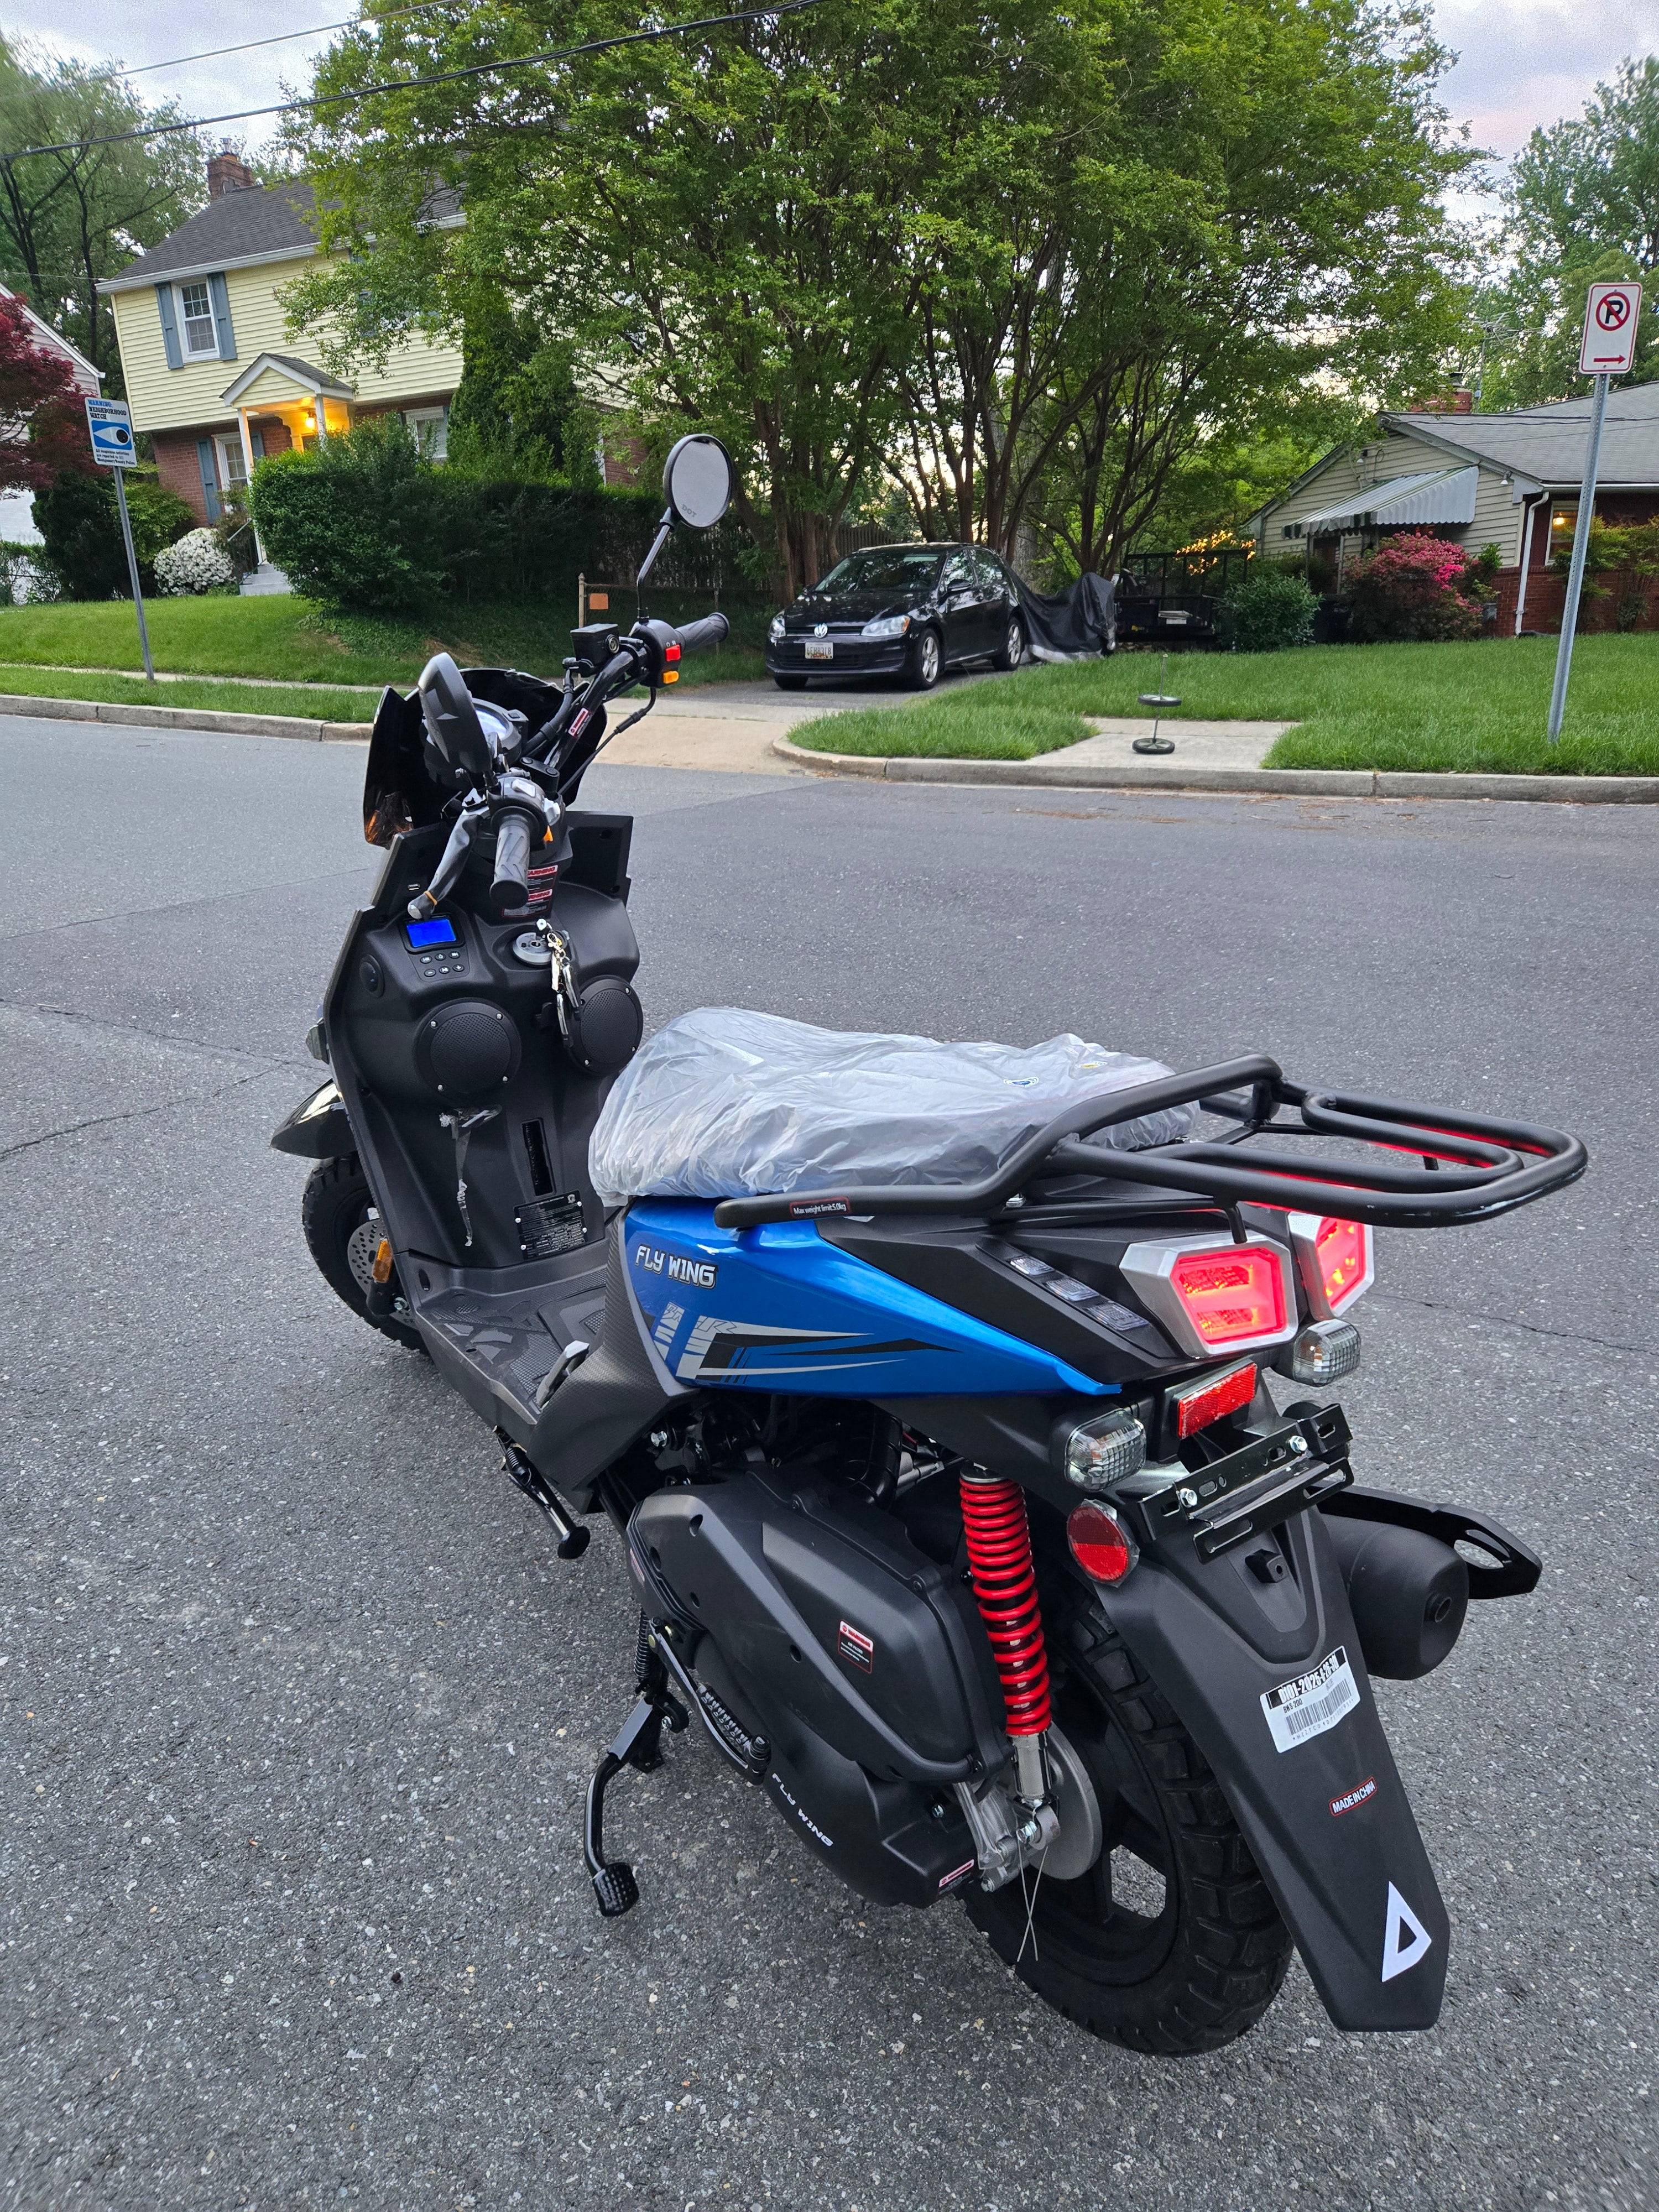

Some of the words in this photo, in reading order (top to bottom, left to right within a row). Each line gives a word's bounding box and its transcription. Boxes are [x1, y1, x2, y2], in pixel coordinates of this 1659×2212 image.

[88, 406, 127, 415] NEIGHBORHOOD
[805, 1206, 821, 1214] weight
[635, 1245, 666, 1275] FLY
[668, 1254, 717, 1289] WING
[773, 1773, 796, 1806] FLY
[798, 1808, 833, 1846] WING
[1332, 1795, 1354, 1813] MADE
[1352, 1791, 1361, 1803] IN
[1359, 1781, 1375, 1798] CHINA
